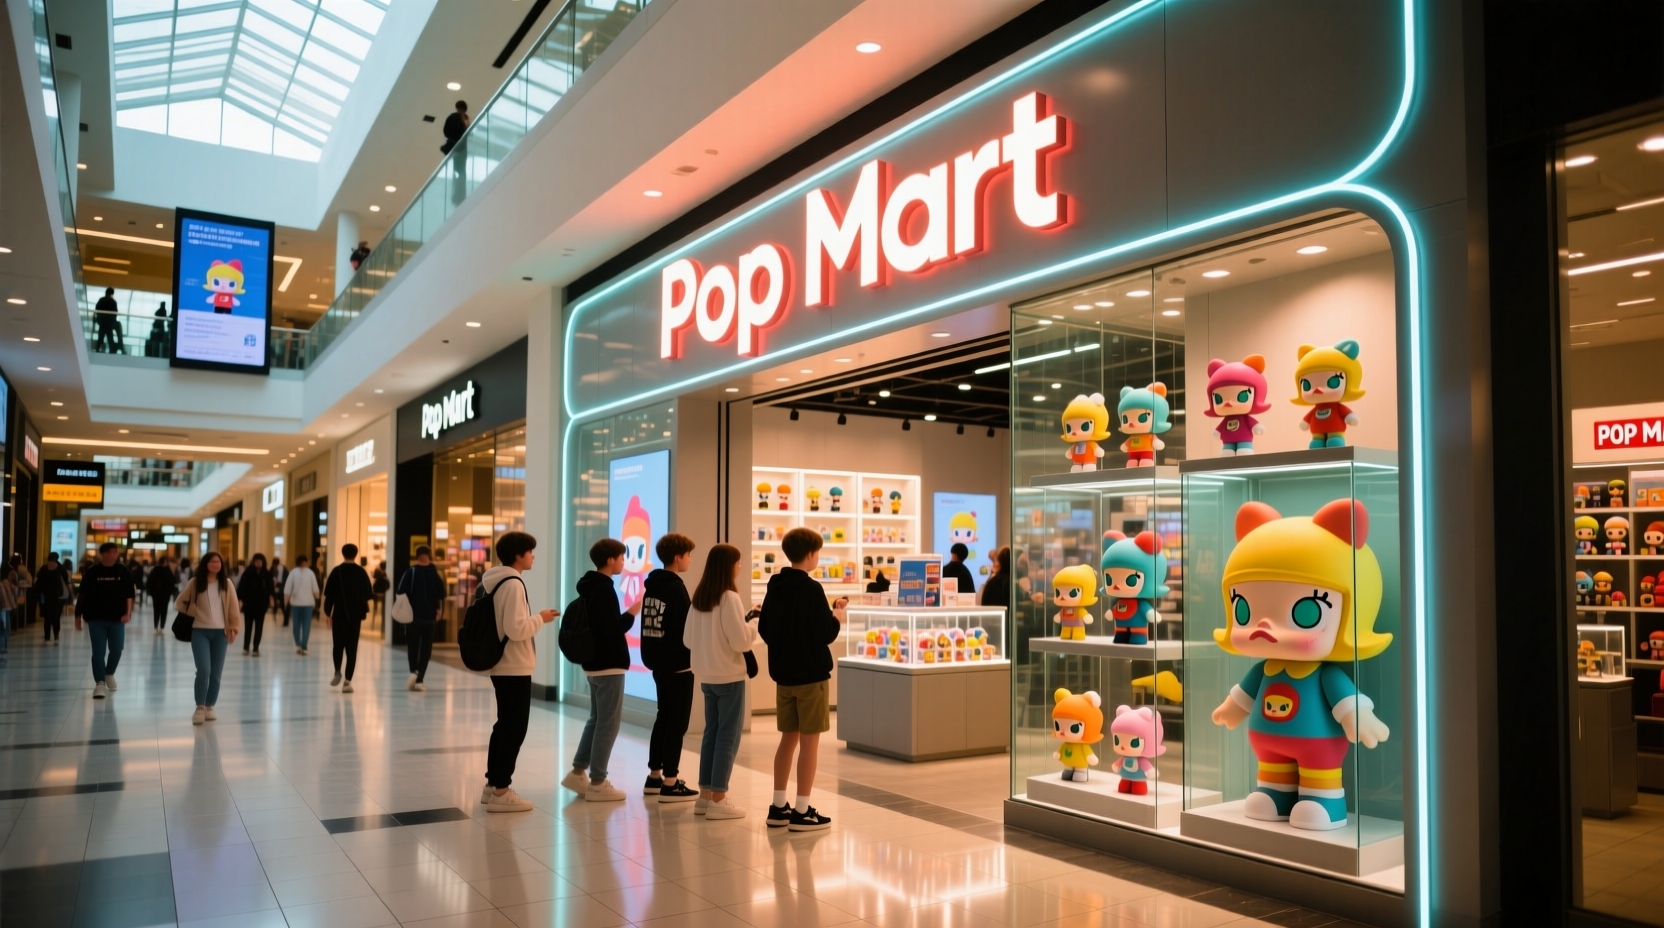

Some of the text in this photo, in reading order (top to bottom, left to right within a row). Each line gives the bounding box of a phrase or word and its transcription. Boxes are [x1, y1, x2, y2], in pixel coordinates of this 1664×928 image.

[660, 91, 1065, 360] Pop Mart
[421, 403, 443, 440] Pop
[1598, 420, 1664, 446] POP M
